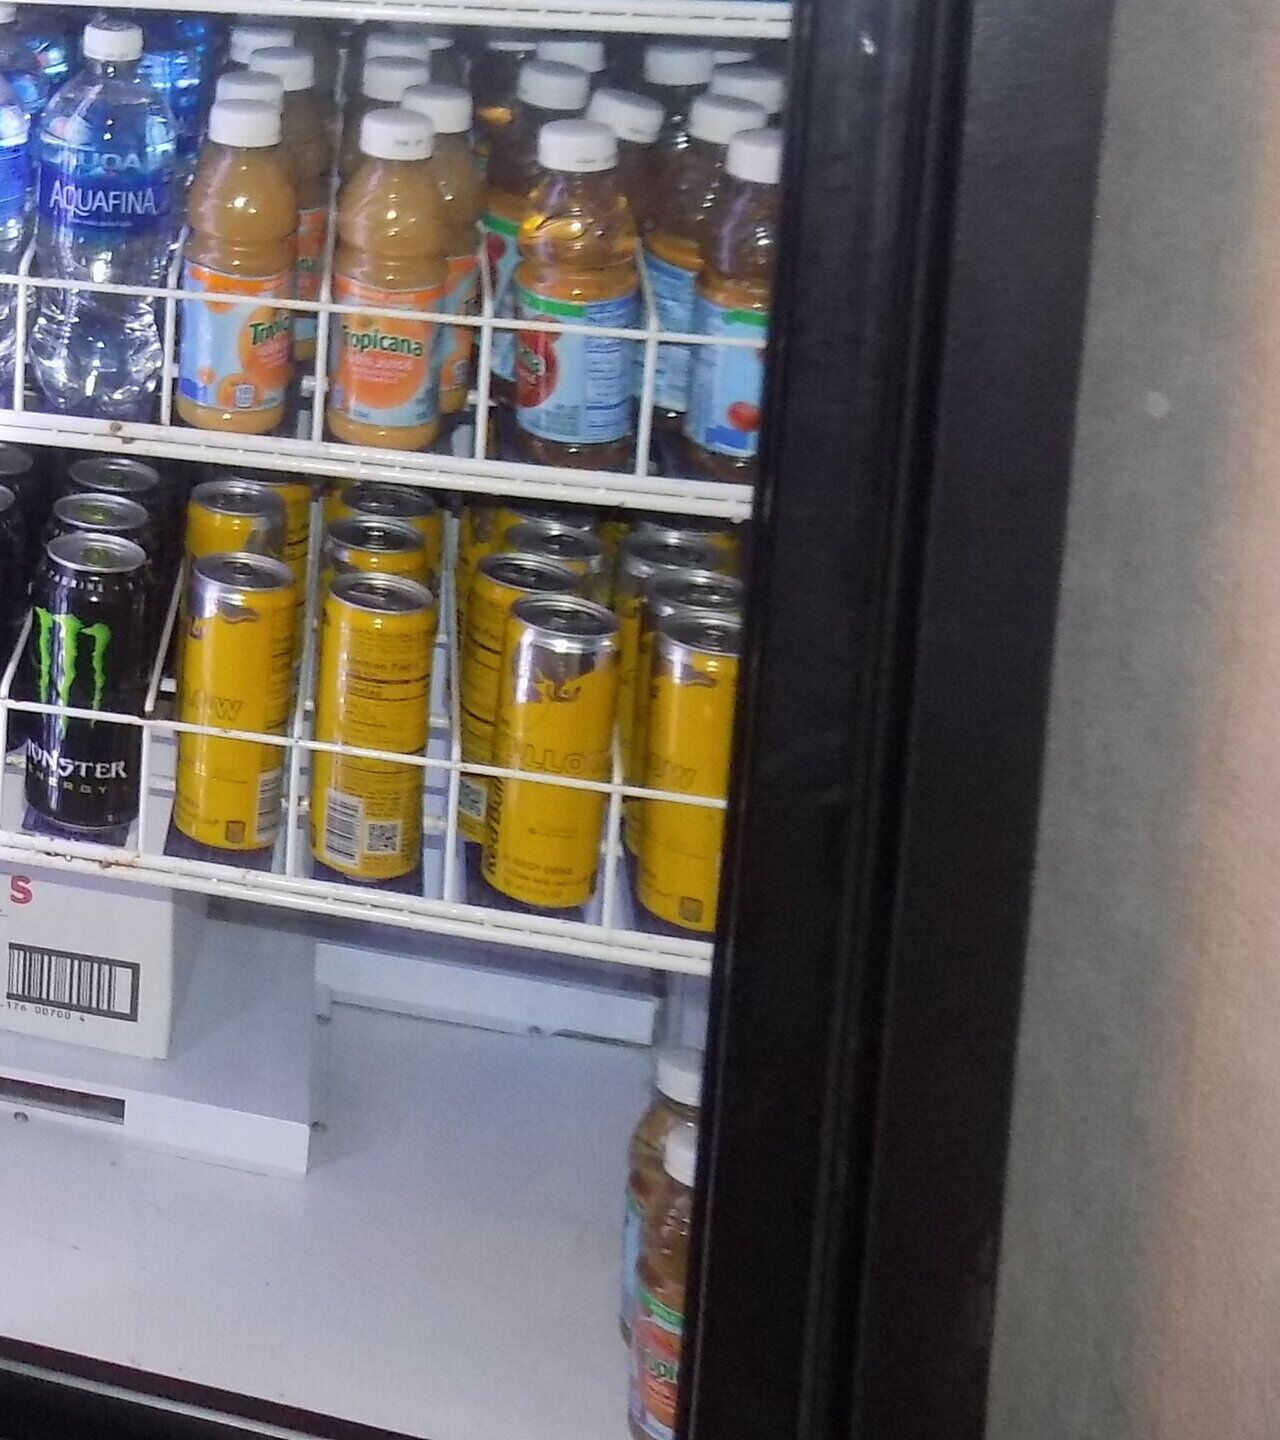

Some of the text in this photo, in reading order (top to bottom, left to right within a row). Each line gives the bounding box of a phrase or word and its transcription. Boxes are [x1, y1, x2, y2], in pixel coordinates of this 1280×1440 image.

[49, 179, 160, 216] AQUAFINA
[10, 875, 33, 905] S
[35, 1005, 72, 1021] 00700
